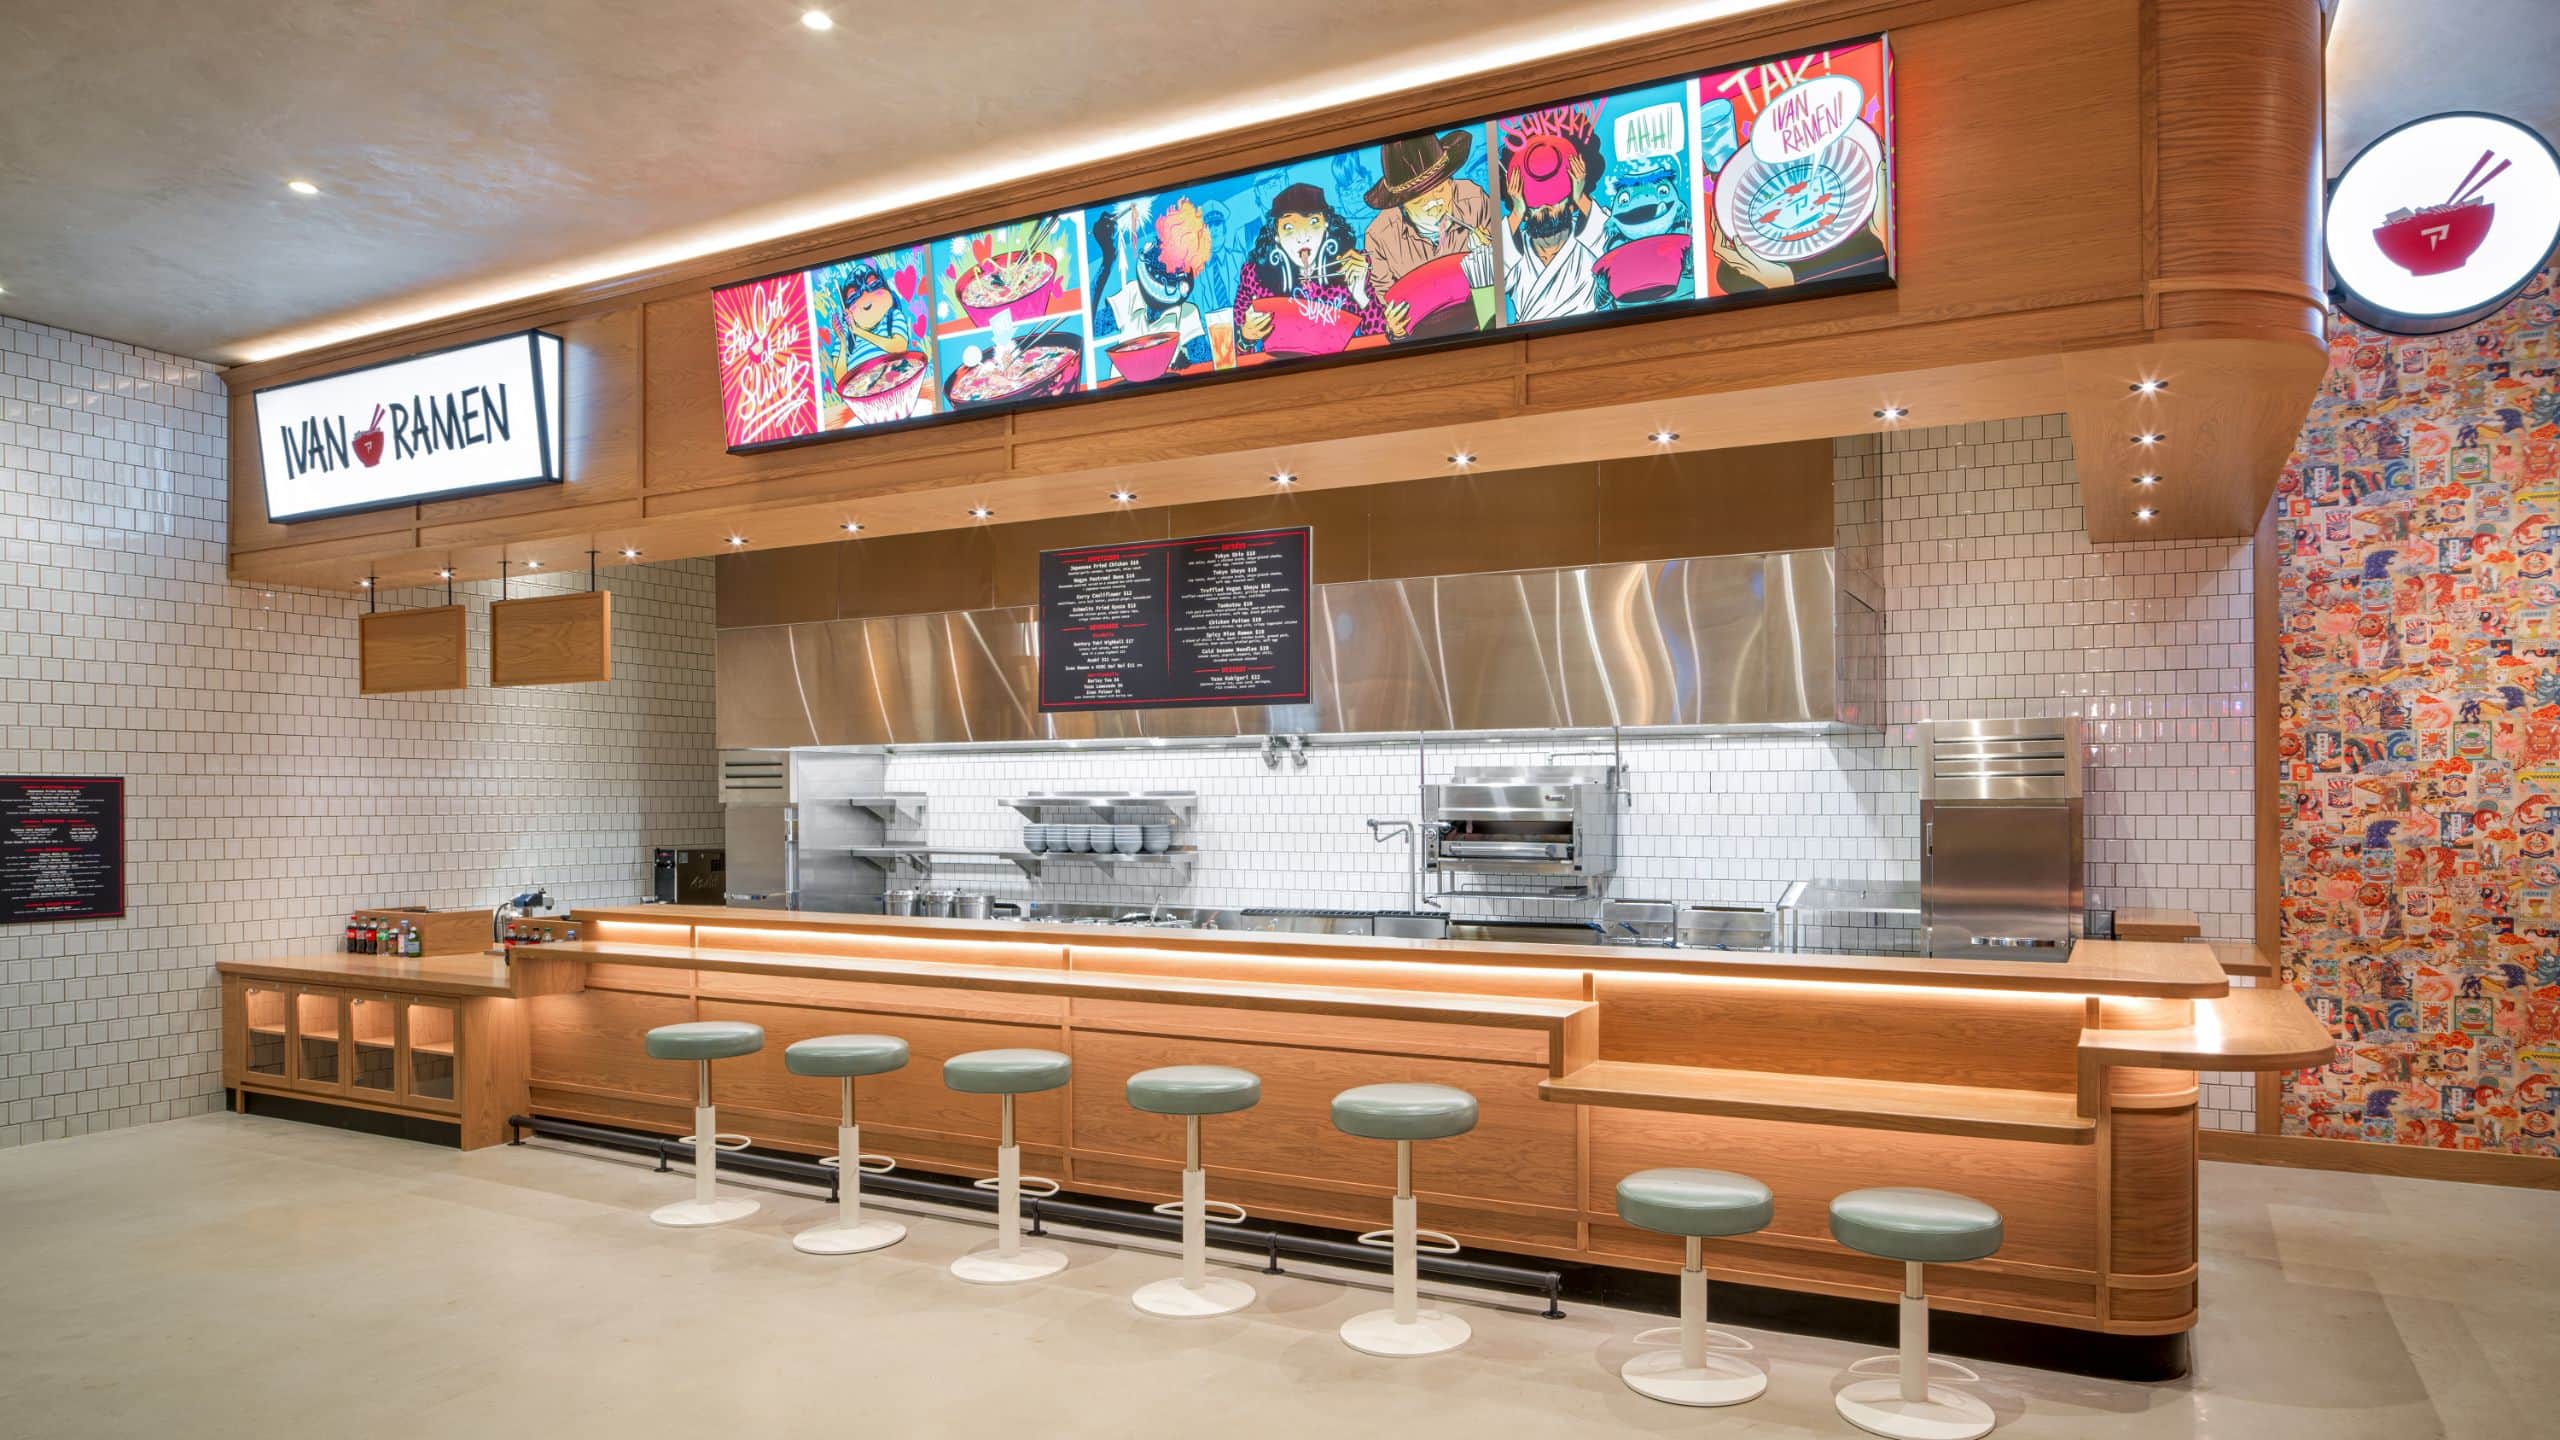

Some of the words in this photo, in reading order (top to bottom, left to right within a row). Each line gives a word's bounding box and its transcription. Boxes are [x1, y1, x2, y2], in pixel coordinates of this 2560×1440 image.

[1772, 90, 1809, 132] IVAN
[1781, 91, 1843, 154] RAMEN!
[723, 317, 753, 365] The
[753, 281, 791, 341] Art
[761, 335, 776, 367] of
[771, 323, 800, 354] the
[738, 354, 810, 421] Slurp
[280, 415, 350, 480] IVAN
[389, 383, 511, 460] RAMEN
